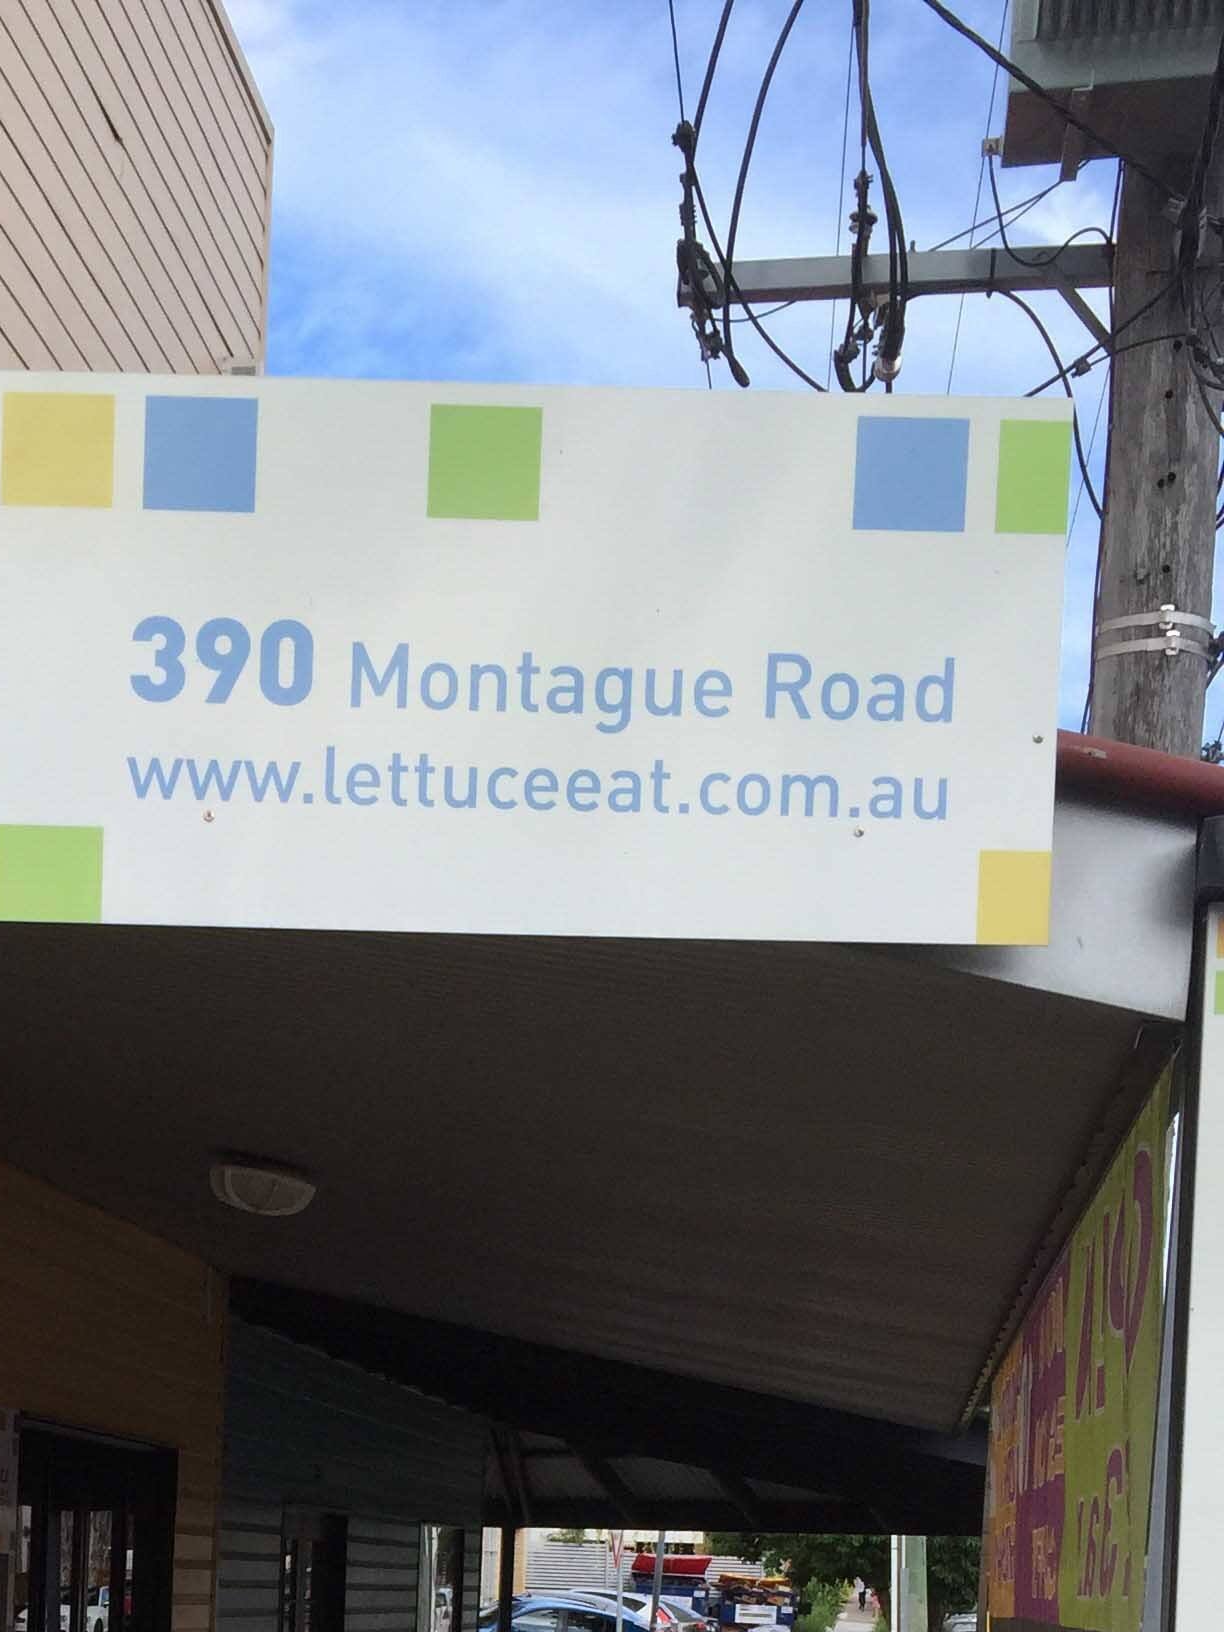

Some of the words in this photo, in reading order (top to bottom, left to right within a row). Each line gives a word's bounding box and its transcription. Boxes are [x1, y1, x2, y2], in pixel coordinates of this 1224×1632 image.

[130, 616, 314, 706] 390
[350, 643, 734, 734] Montague
[764, 653, 955, 723] Road
[128, 745, 950, 821] www.lettuceeat.com.au
